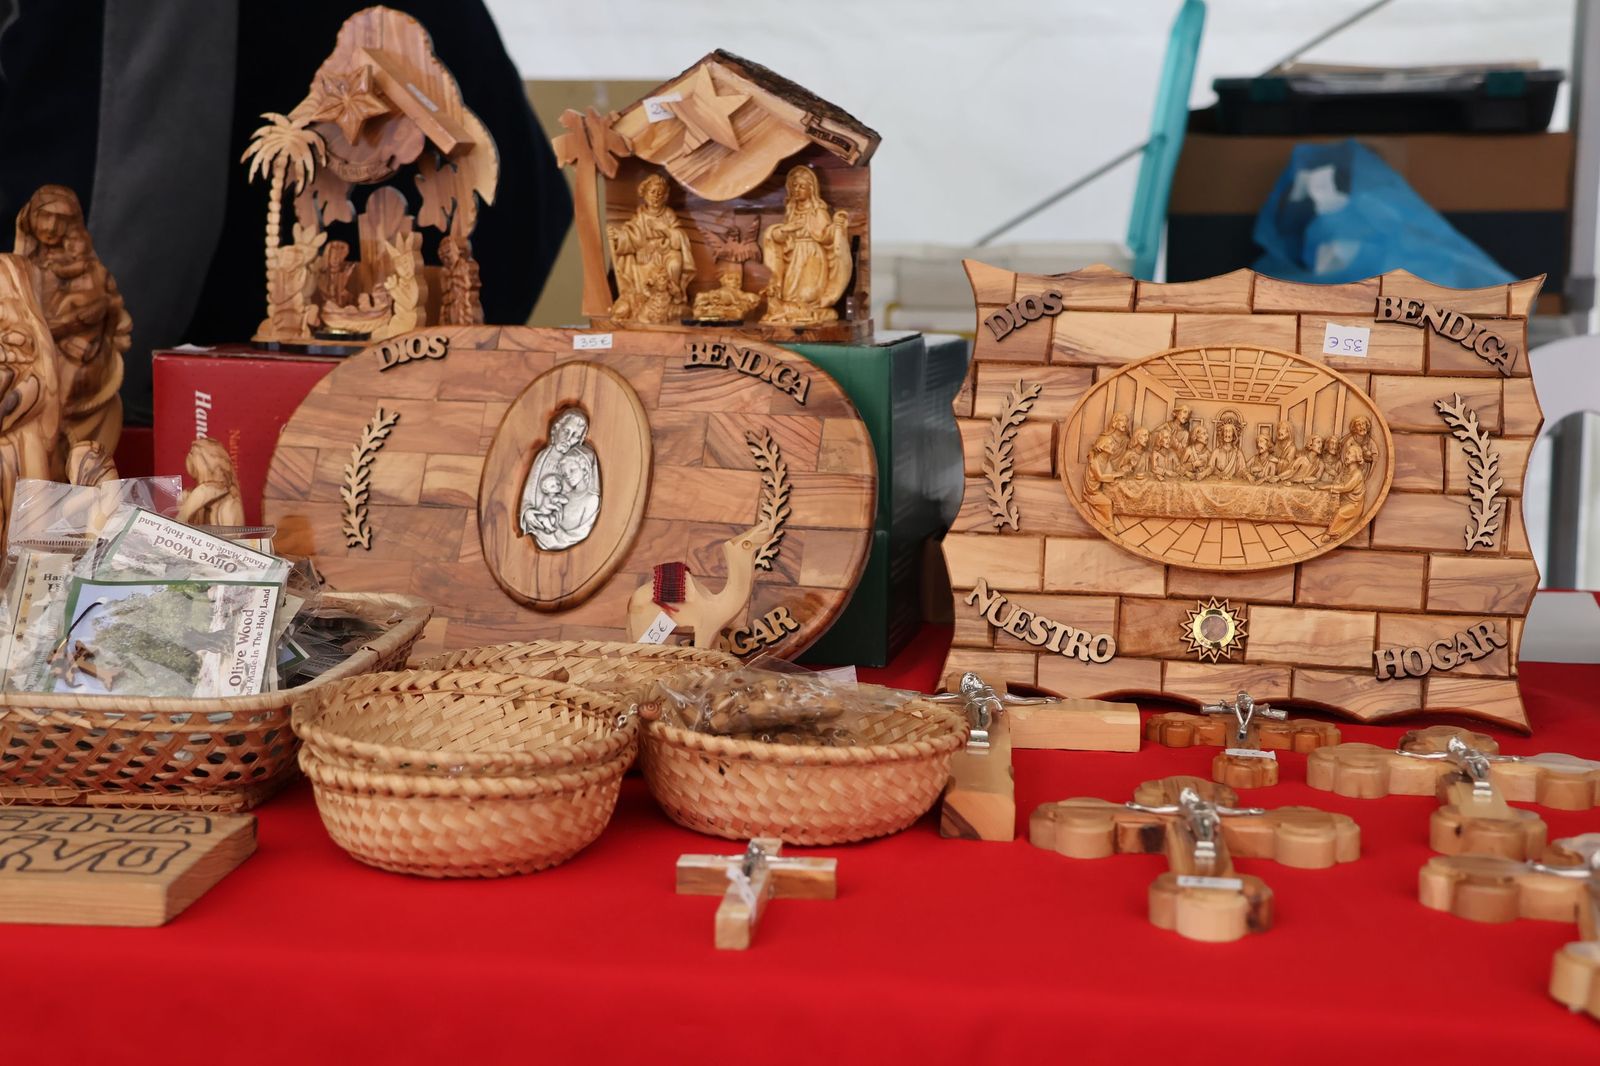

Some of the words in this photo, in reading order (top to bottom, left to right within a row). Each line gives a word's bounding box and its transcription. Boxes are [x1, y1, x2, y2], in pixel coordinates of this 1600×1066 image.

[984, 289, 1063, 342] DIOS
[1375, 295, 1518, 377] BENDIGA
[375, 335, 449, 371] DIOS
[684, 342, 811, 406] BENDIGA
[138, 516, 162, 531] Land
[163, 522, 185, 539] Holy
[153, 535, 193, 560] Wood
[186, 533, 203, 547] The
[199, 551, 238, 574] Olive
[218, 546, 242, 561] Made
[242, 555, 268, 570] Hand
[260, 588, 271, 608] Land
[236, 608, 255, 646] Wood
[256, 610, 268, 630] Holy
[721, 606, 799, 657] GAR
[963, 576, 1117, 664] NUESTRO
[253, 631, 263, 647] The
[1373, 620, 1508, 681] HOGAR
[228, 650, 247, 687] Olive
[247, 662, 258, 685] Made
